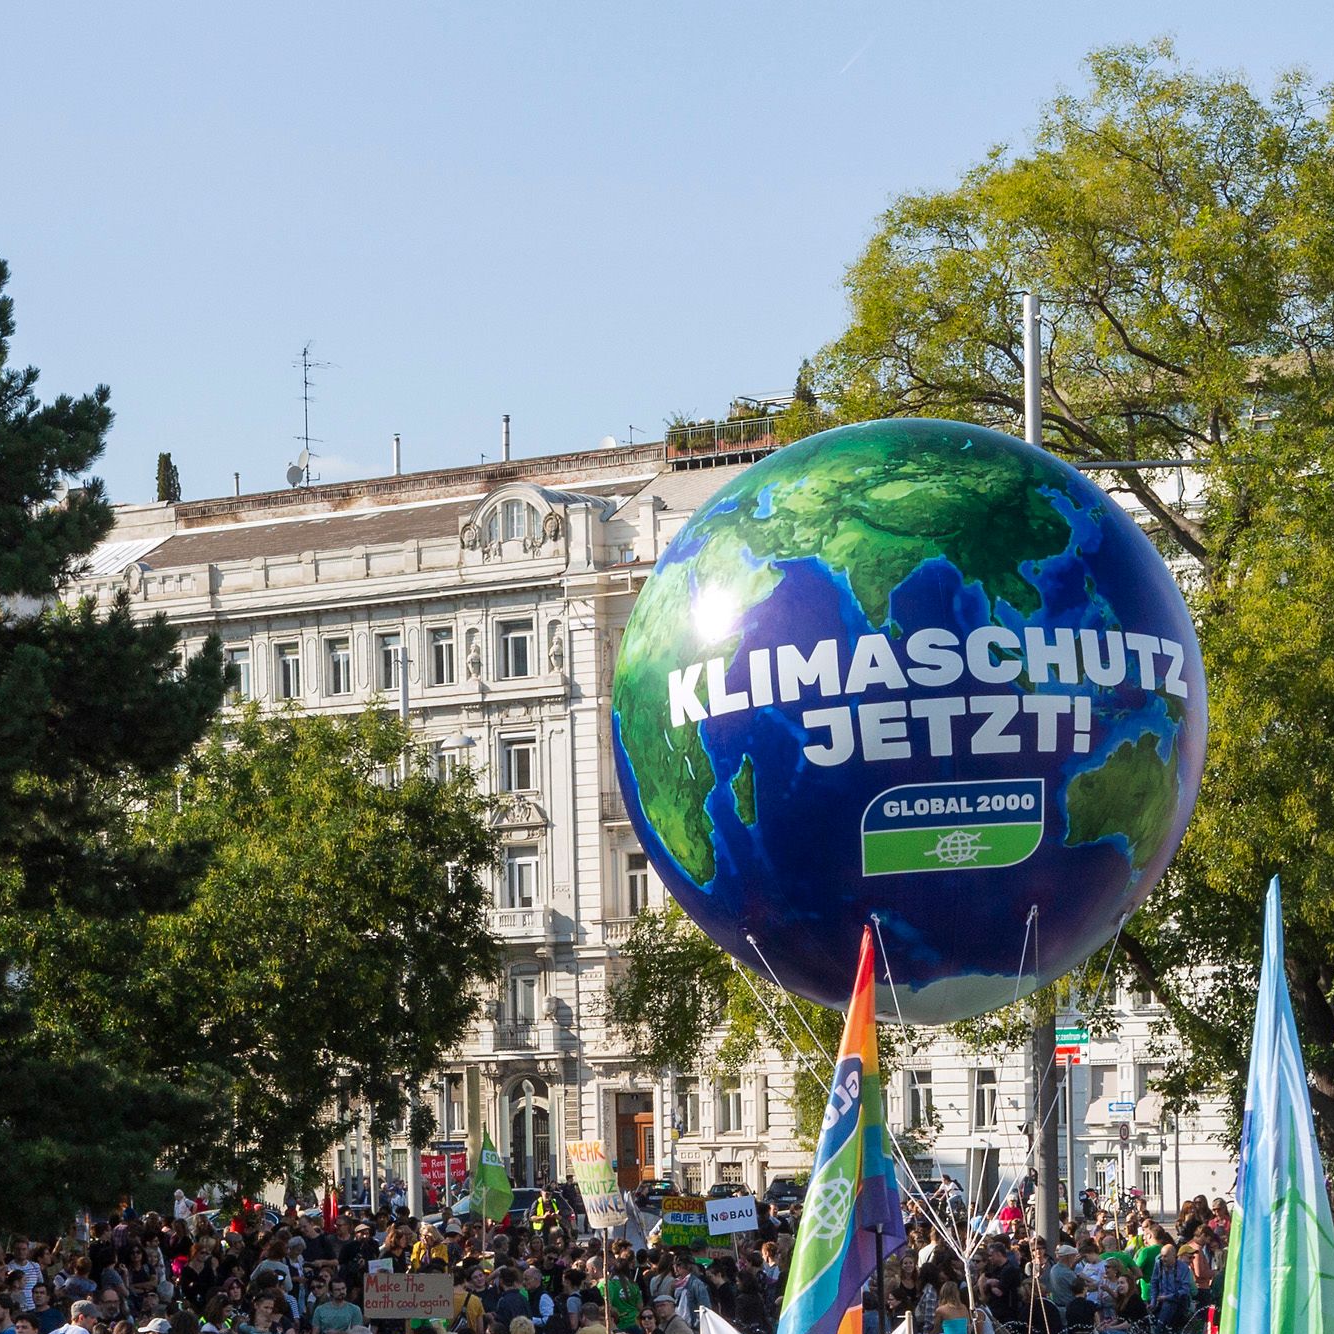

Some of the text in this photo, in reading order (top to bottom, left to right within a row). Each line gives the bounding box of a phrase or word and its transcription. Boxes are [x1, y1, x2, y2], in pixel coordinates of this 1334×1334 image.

[667, 625, 1189, 728] KLIMASCHUTZ
[801, 695, 1092, 768] JETZT!
[882, 792, 1035, 818] GLOBAL 2000
[567, 1141, 606, 1162] MEHR
[366, 1275, 401, 1293] Make
[365, 1293, 394, 1310] earth
[419, 1294, 450, 1315] again
